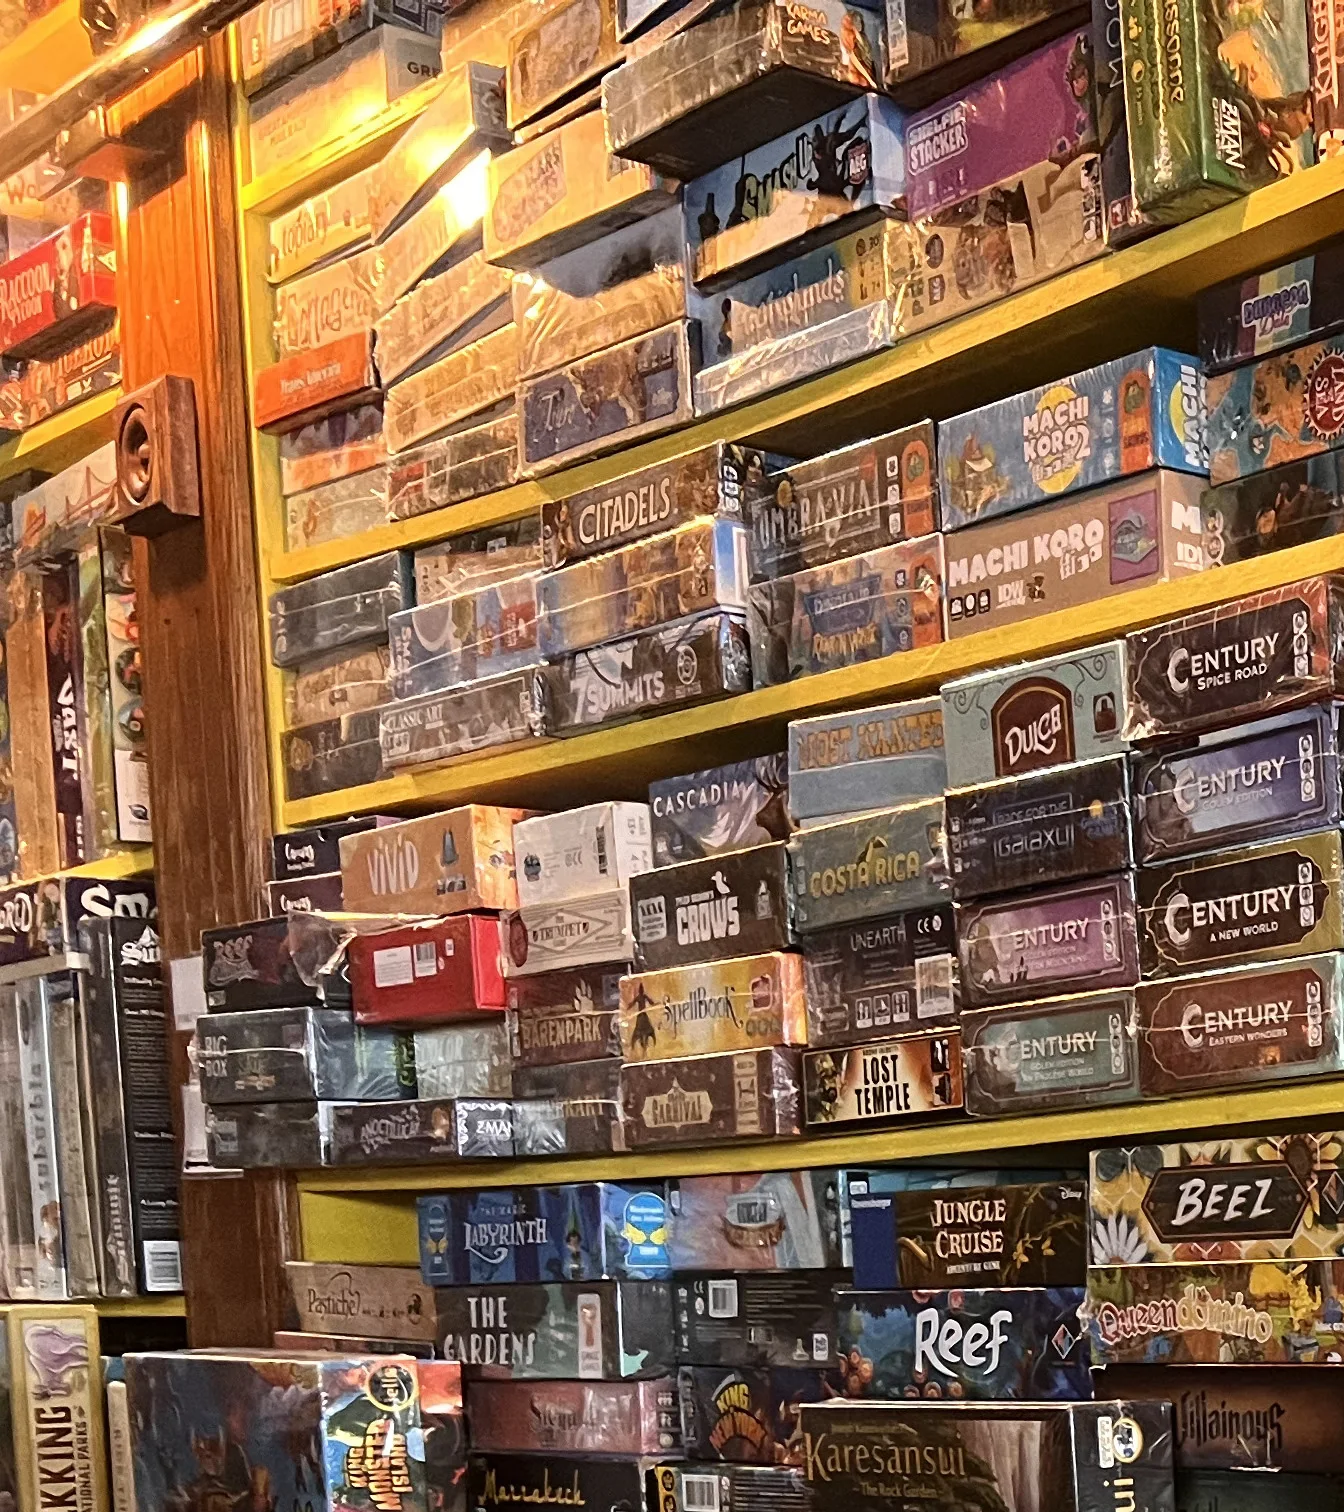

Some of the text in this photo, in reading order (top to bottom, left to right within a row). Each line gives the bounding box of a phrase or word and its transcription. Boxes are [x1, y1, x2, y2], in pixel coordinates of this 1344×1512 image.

[1023, 396, 1090, 437] MACHI
[578, 476, 673, 545] CITADELS
[948, 519, 1105, 589] MACHI KORO
[1168, 632, 1280, 694] CENTURY
[1197, 662, 1268, 692] SPICE ROAD
[1174, 755, 1287, 815] CENTURY
[810, 850, 921, 897] COSTA RICA
[676, 891, 740, 946] CROWS
[849, 921, 907, 953] UNEARTH
[1164, 884, 1297, 946] CENTURY
[1219, 920, 1280, 942] NEW WORLD
[1180, 1000, 1294, 1051] CENTURY
[862, 1054, 899, 1087] LOST
[854, 1082, 911, 1116] TEMPLE
[930, 1198, 1008, 1229] JUNGLE
[1173, 1177, 1275, 1227] BEEZ
[934, 1229, 1005, 1259] CRUISE
[466, 1295, 509, 1330] THE
[443, 1330, 537, 1366] GARDENS
[914, 1306, 1013, 1379] Reef
[75, 1420, 91, 1461] PARKS
[804, 1431, 966, 1483] Karesansui
